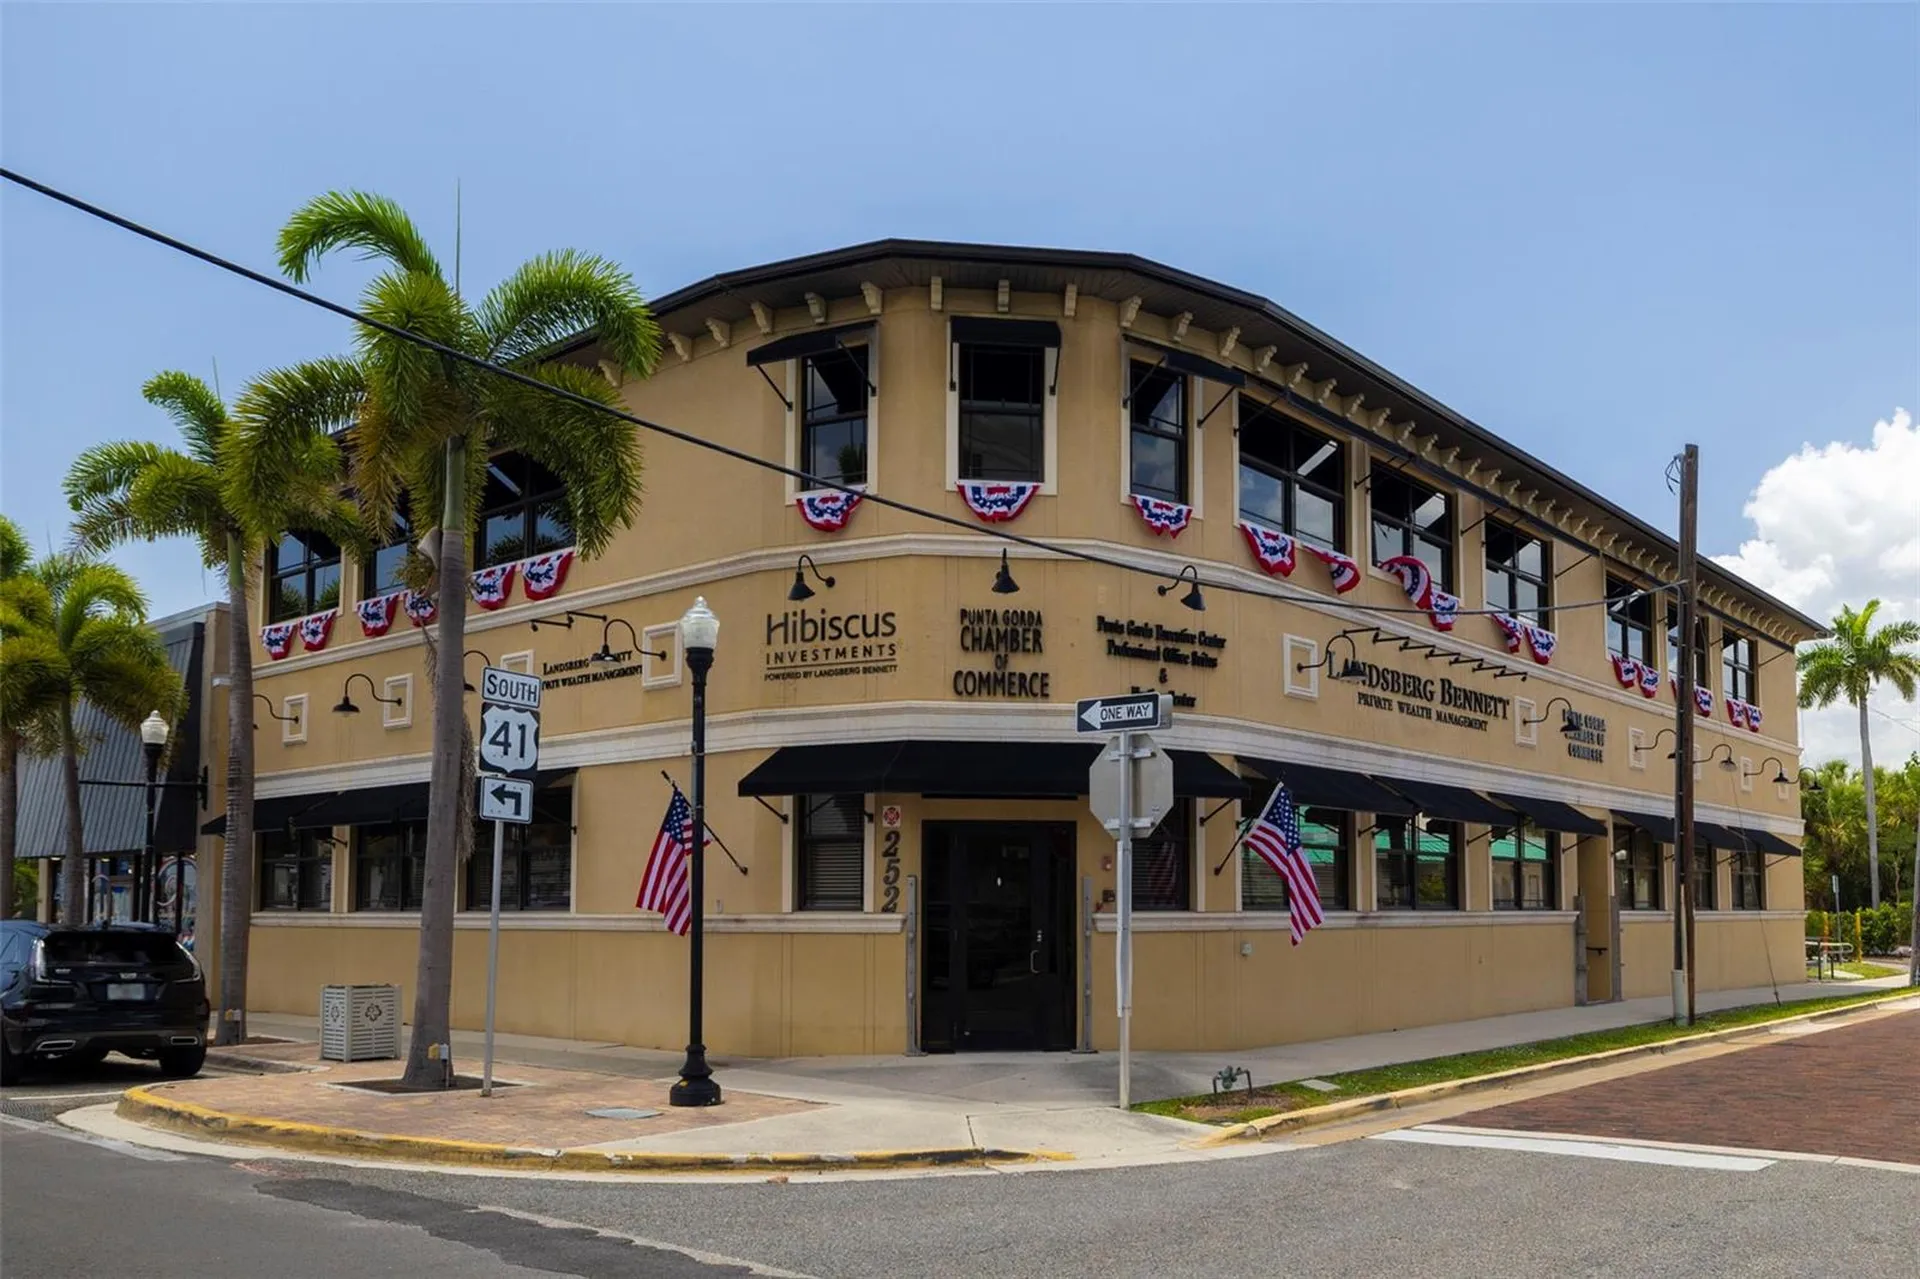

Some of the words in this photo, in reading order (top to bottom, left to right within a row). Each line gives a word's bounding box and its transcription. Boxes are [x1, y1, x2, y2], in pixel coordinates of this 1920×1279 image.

[767, 608, 896, 645] Hibiscus
[960, 609, 998, 625] PUNTA
[1002, 609, 1042, 626] GORDA
[960, 626, 1042, 653] CHAMBER
[766, 643, 896, 665] INVESTMENTS
[994, 654, 1008, 670] OF
[487, 674, 537, 703] SOUTH
[953, 670, 1049, 697] COMMERCE
[1100, 706, 1122, 721] ONE
[1127, 703, 1149, 719] WAY
[1358, 692, 1393, 711] PRIVATE
[1397, 701, 1432, 720] WEALTH
[1436, 710, 1488, 732] MANAGEMENT
[1440, 678, 1510, 720] BENNETT
[488, 720, 526, 758] 41
[882, 830, 900, 913] 252
